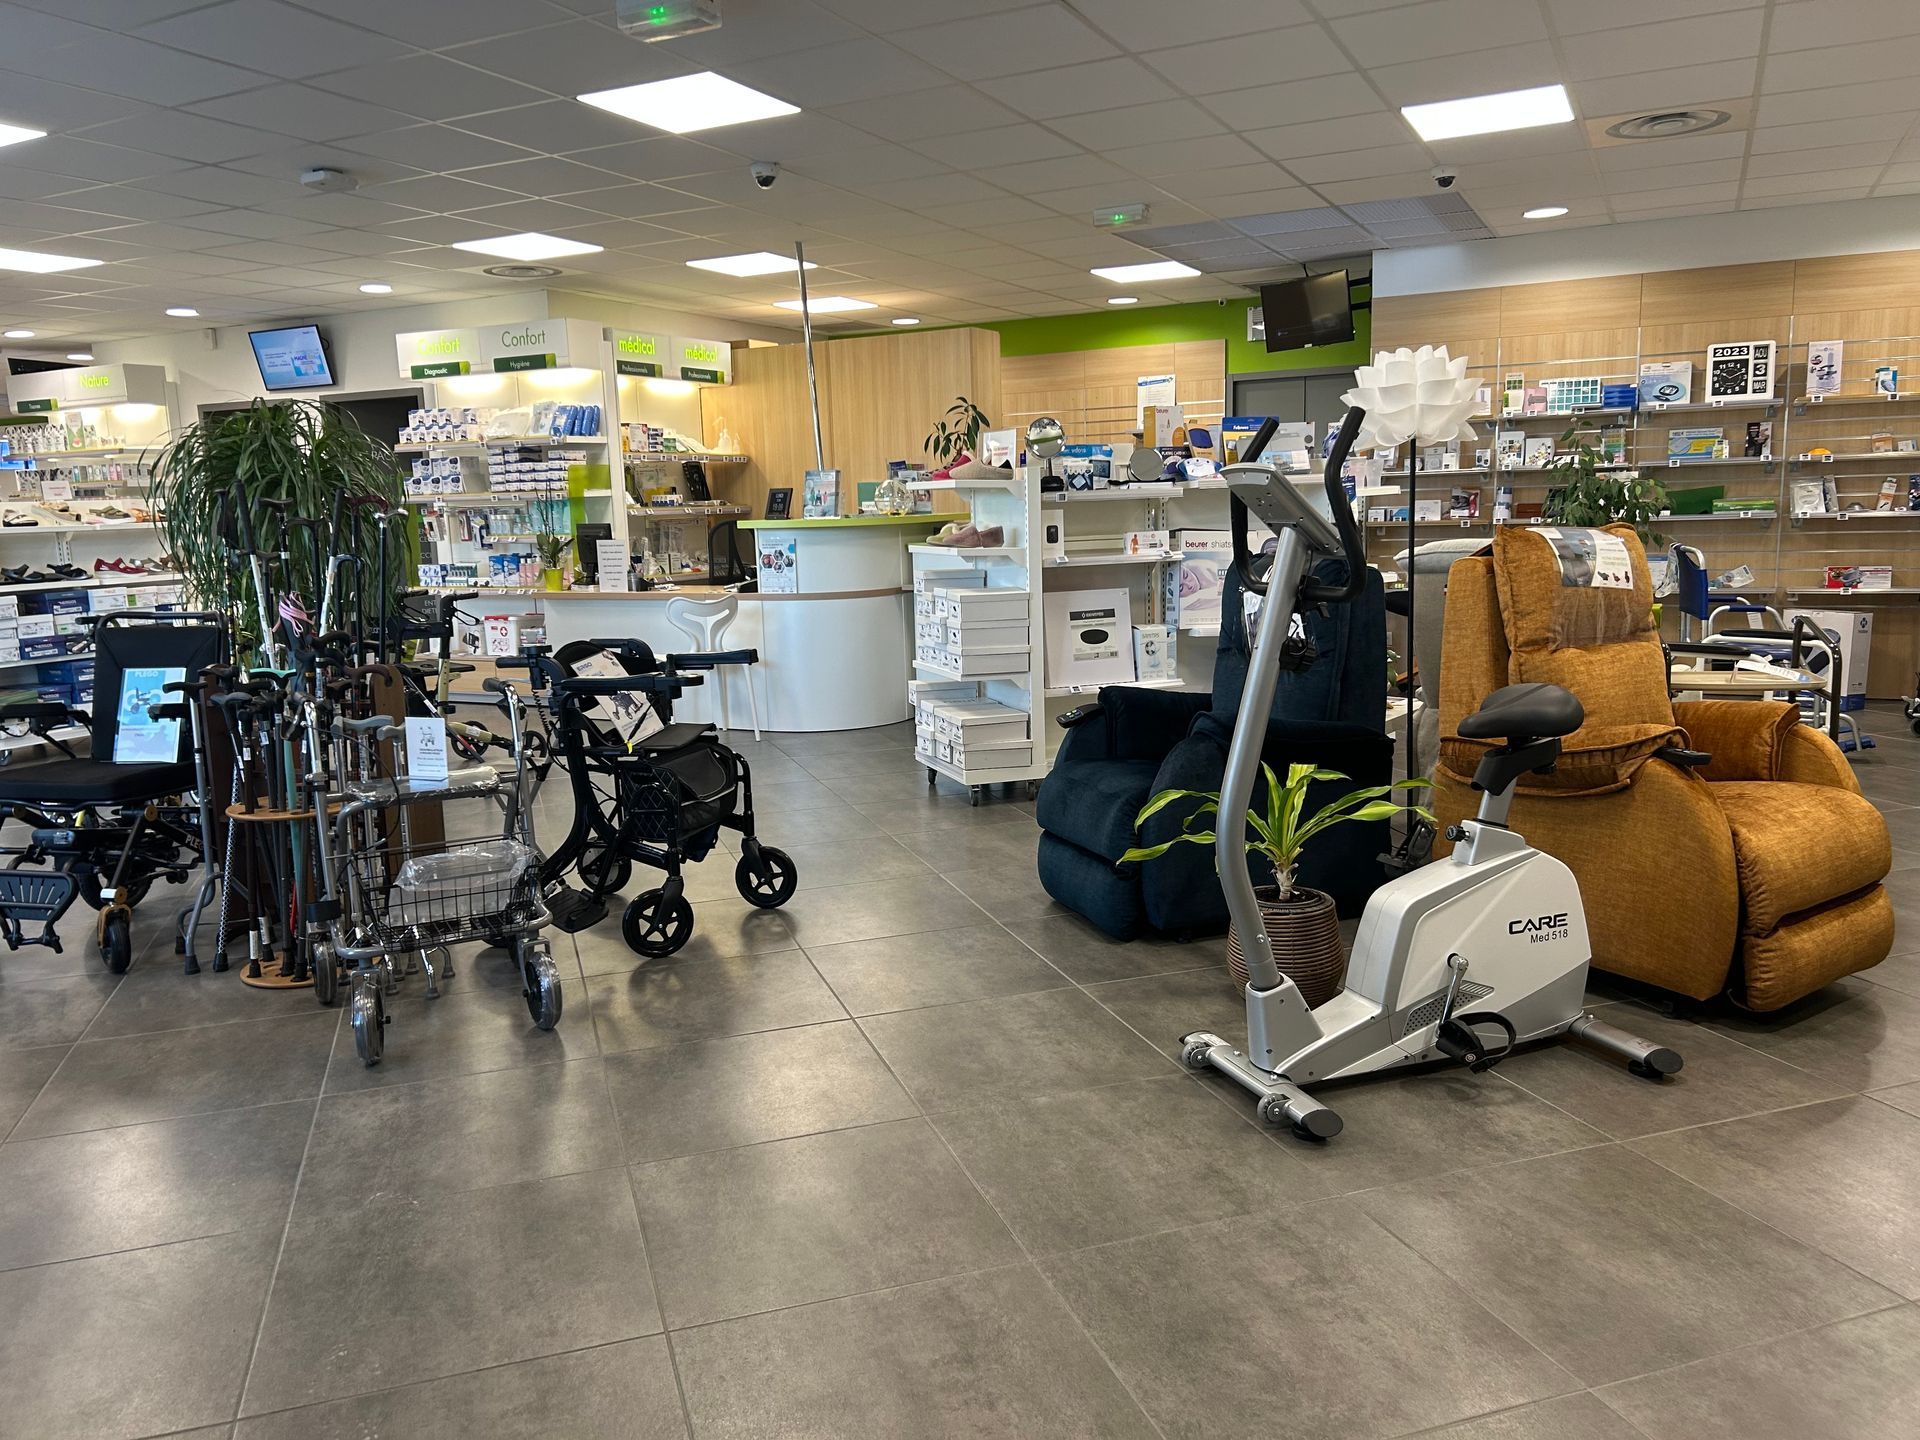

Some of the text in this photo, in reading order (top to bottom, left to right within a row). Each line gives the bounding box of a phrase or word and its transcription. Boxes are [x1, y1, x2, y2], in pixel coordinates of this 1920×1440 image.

[502, 328, 546, 348] Confort
[417, 335, 460, 356] Confort
[619, 336, 655, 355] médical
[1714, 347, 1748, 357] 2023
[685, 345, 718, 362] médical
[424, 367, 448, 376] Diagnostic
[1755, 364, 1766, 375] 3
[80, 374, 109, 388] Nature
[1753, 381, 1766, 389] MAR
[1185, 540, 1232, 548] beurer shiats
[1508, 912, 1568, 935] CARE
[1530, 929, 1568, 944] Med 518
